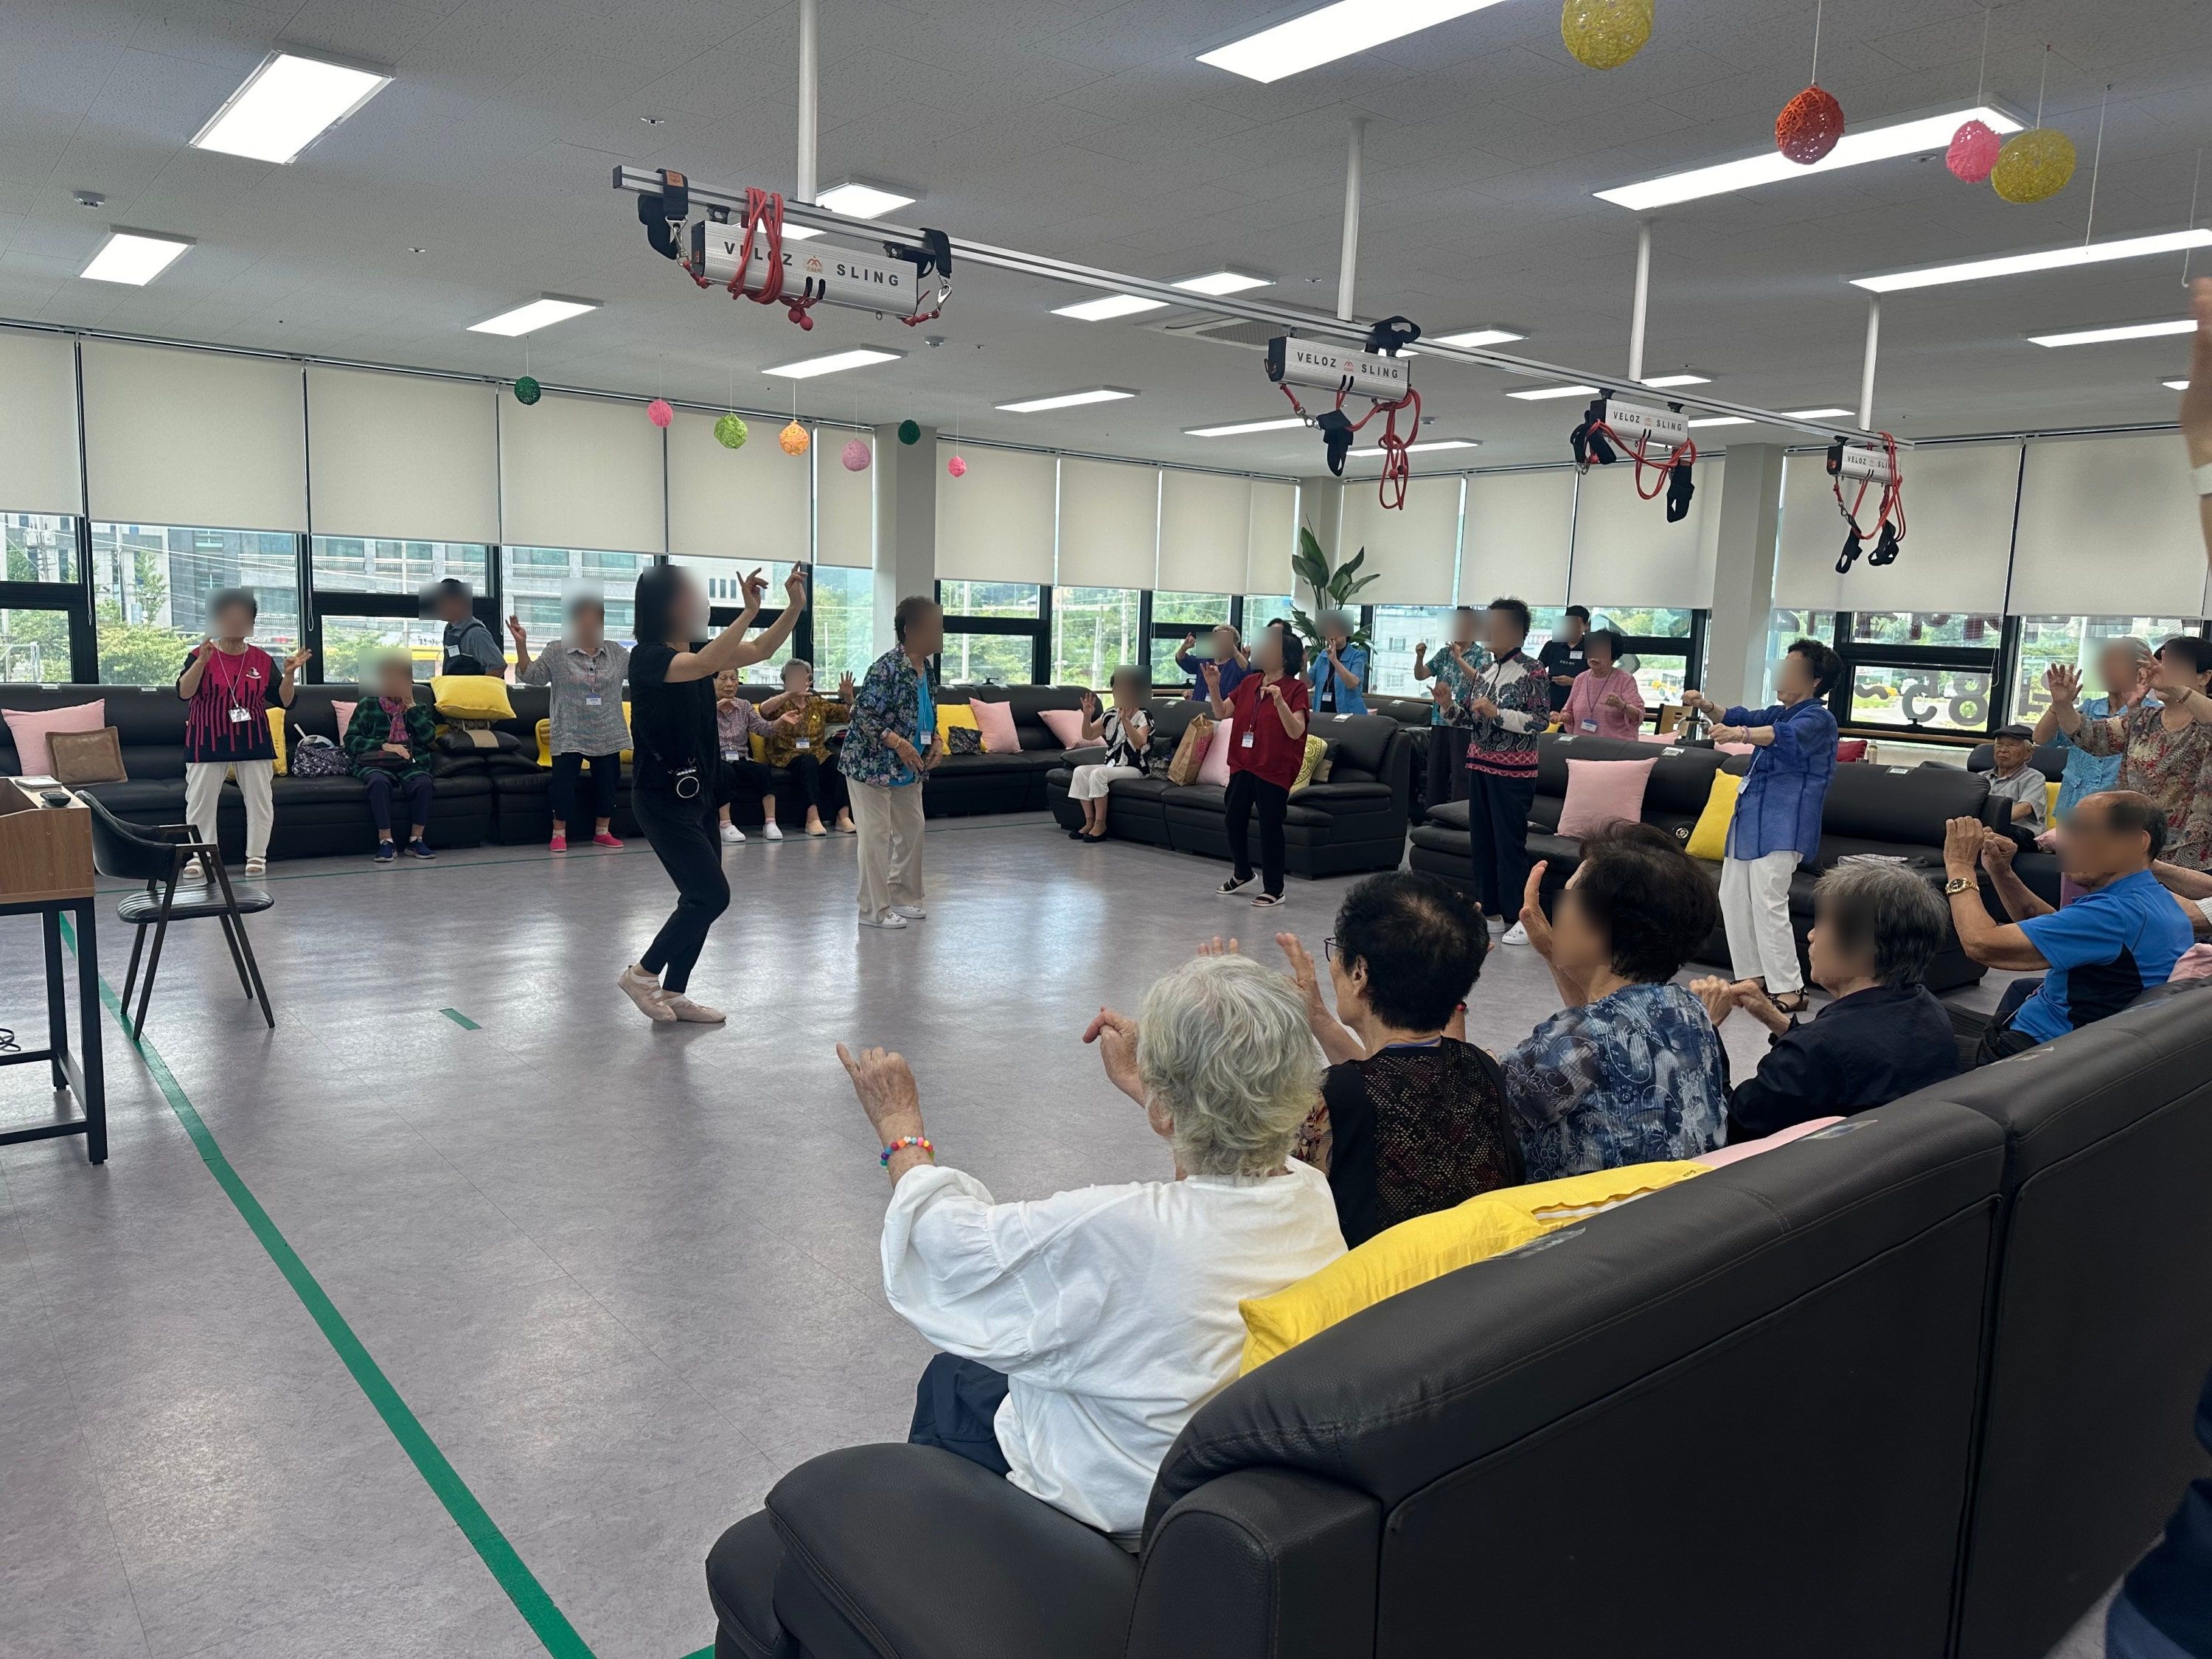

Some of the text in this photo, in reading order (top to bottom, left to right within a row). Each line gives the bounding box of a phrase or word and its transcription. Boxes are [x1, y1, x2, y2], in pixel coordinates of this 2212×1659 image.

[837, 263, 899, 286] SLING
[1297, 352, 1398, 378] VELOZ SLING
[1613, 411, 1640, 424] VELOZ
[1656, 420, 1682, 431] SLING
[1847, 455, 1891, 469] VELOZ SLI
